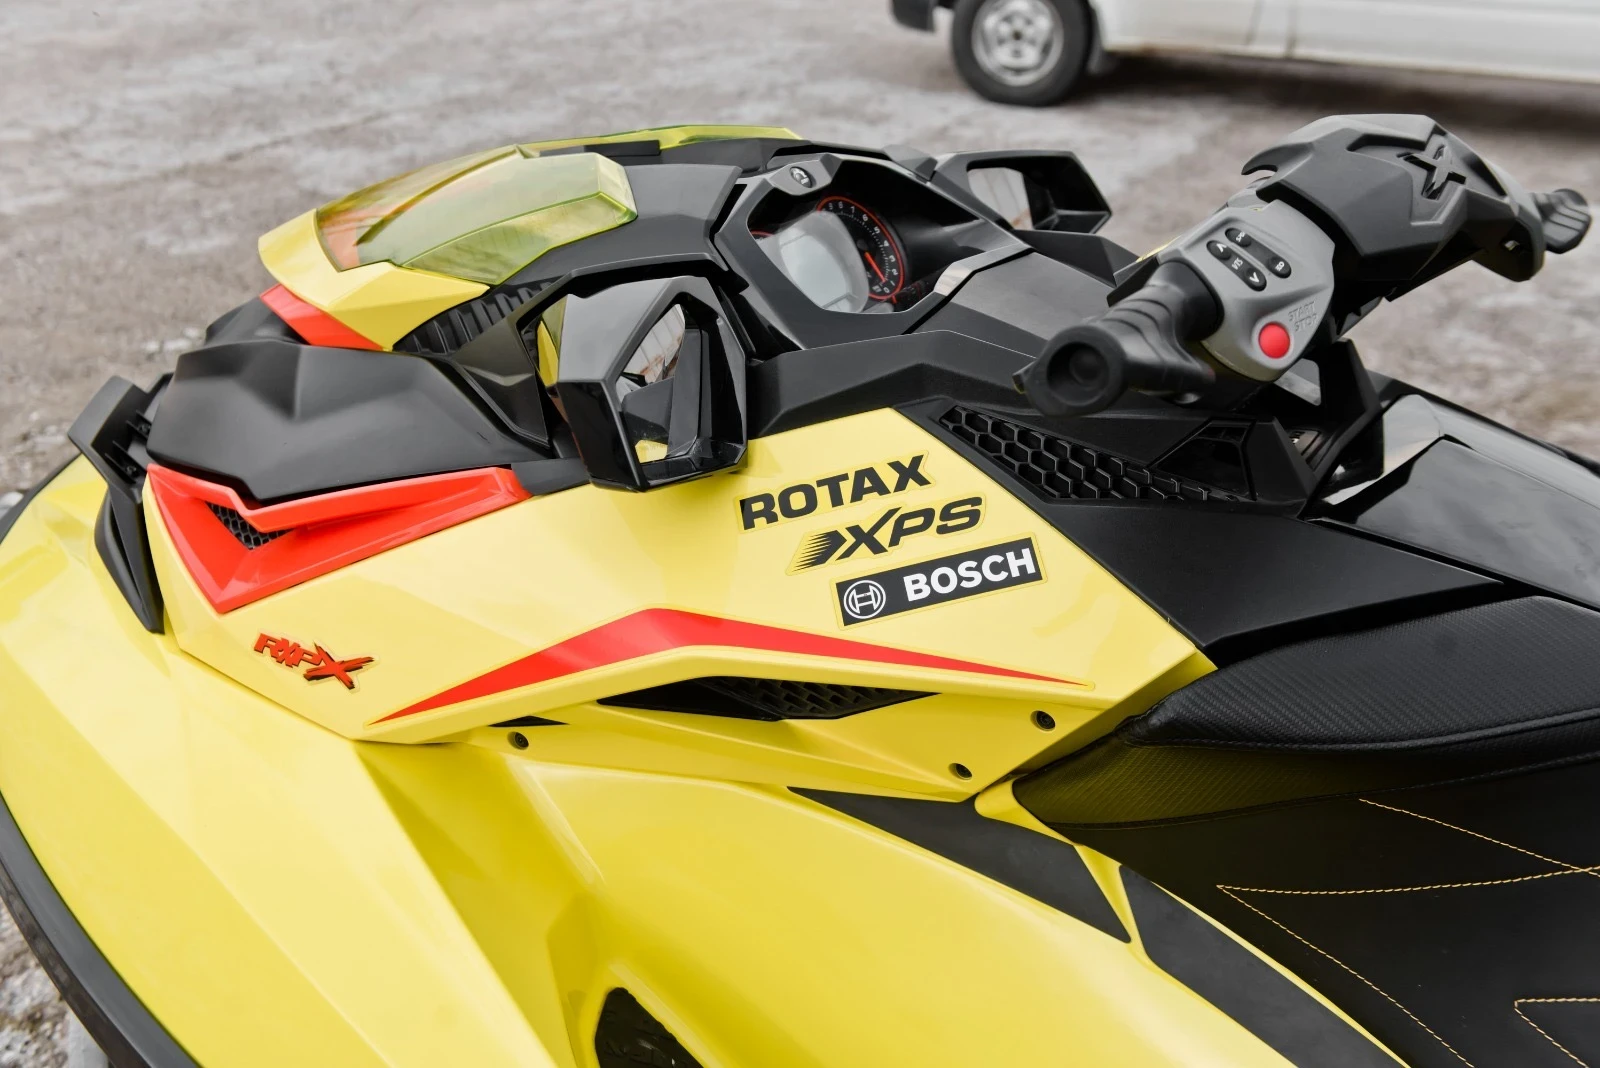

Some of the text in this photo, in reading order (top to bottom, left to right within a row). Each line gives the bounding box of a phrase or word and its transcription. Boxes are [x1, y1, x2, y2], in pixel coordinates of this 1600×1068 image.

[873, 226, 880, 234] 5
[1231, 257, 1244, 270] VTS
[1288, 300, 1316, 322] START
[1294, 313, 1318, 332] STOP
[739, 454, 932, 531] ROTAX
[832, 496, 984, 562] XPS
[903, 547, 1036, 602] BOSCH
